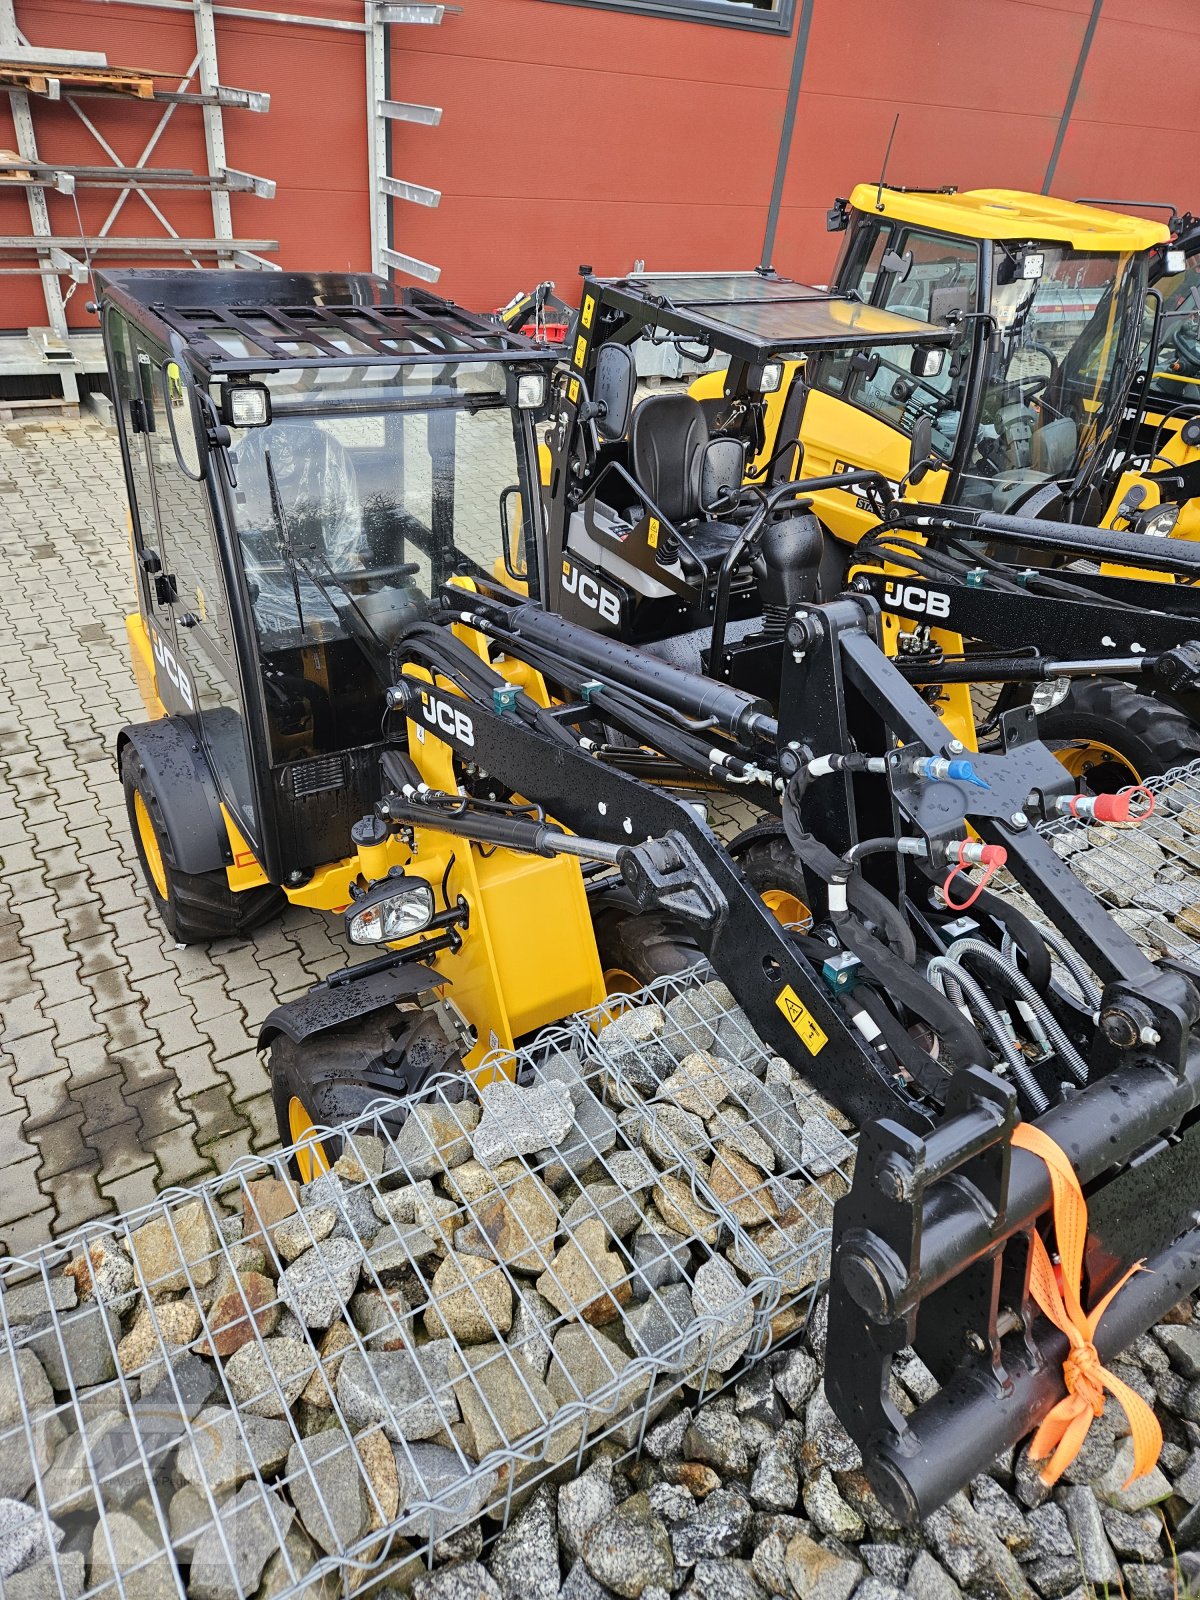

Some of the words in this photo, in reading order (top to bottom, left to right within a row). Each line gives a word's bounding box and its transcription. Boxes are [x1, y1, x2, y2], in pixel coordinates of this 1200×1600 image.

[856, 499, 886, 518] STAE
[562, 566, 621, 625] JCB
[884, 583, 951, 618] JCB
[153, 635, 194, 711] JCB
[422, 695, 475, 747] JCB
